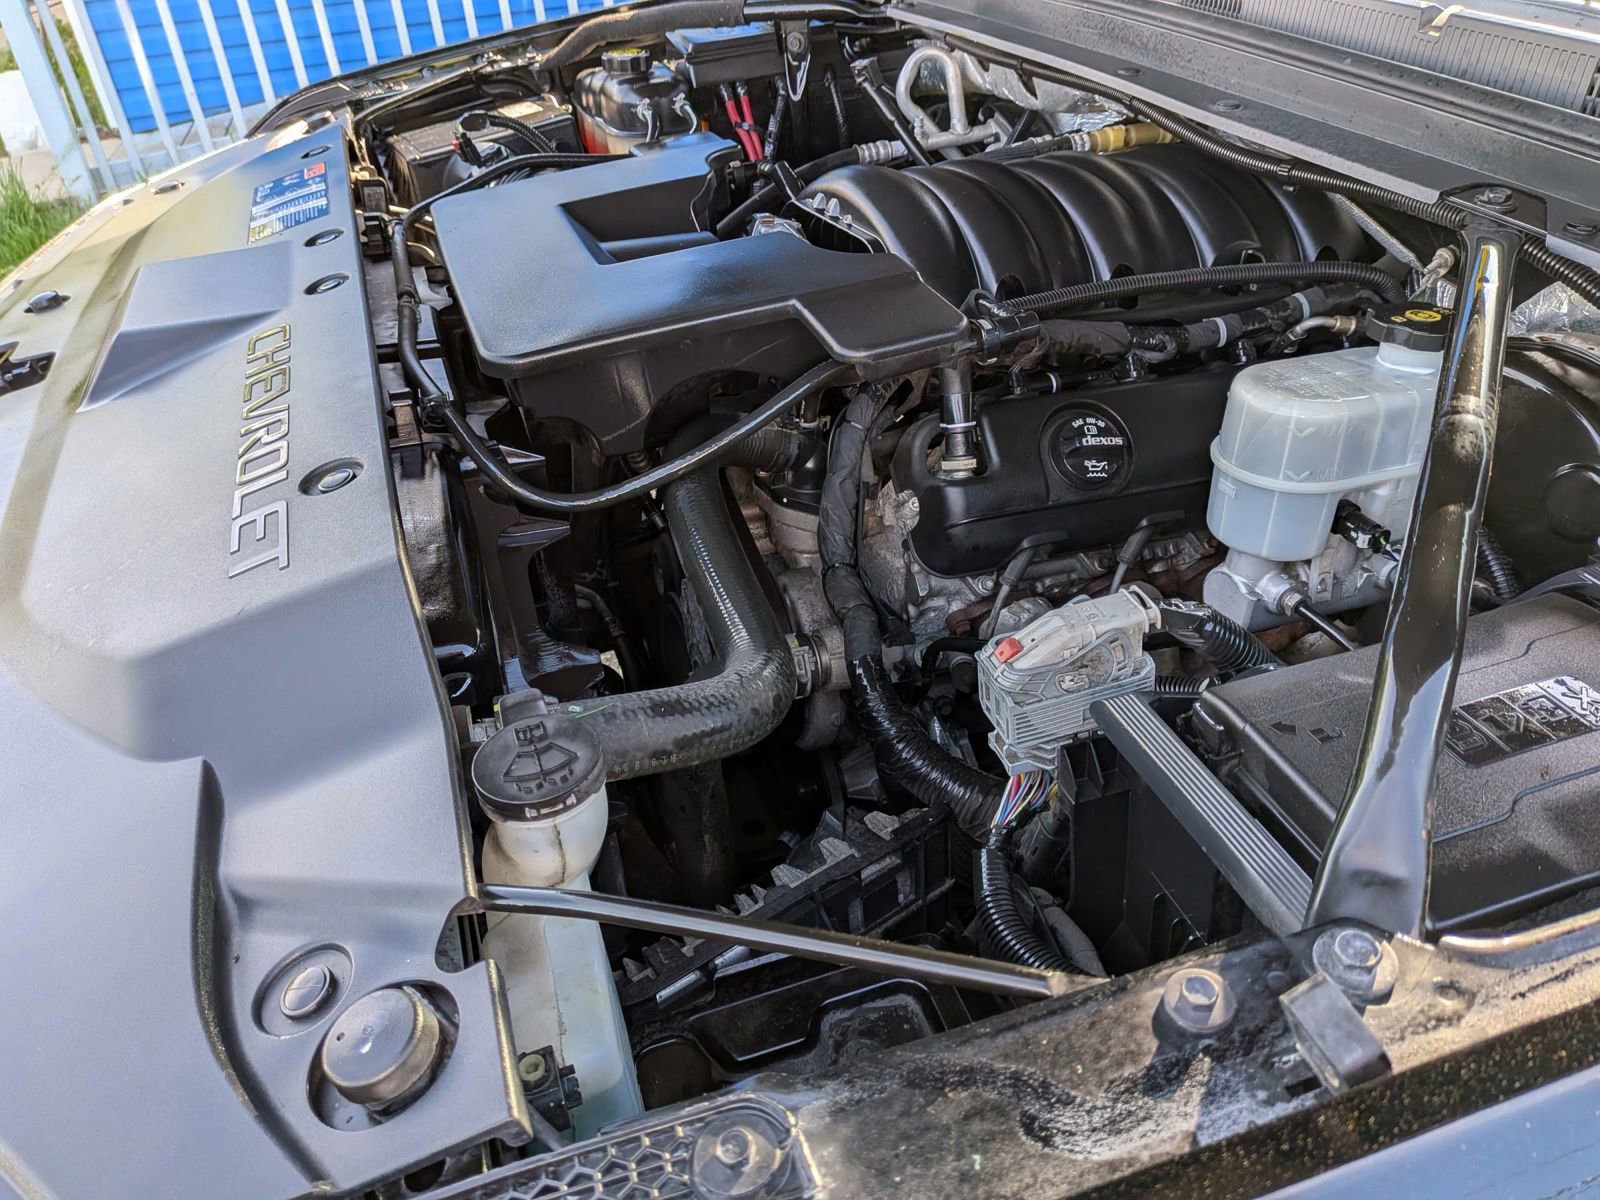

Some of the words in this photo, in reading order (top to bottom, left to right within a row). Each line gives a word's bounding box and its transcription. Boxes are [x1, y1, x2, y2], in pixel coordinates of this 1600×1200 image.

[1072, 418, 1084, 428] SAE
[1082, 435, 1123, 446] dexos
[228, 323, 291, 579] CHEVROLET
